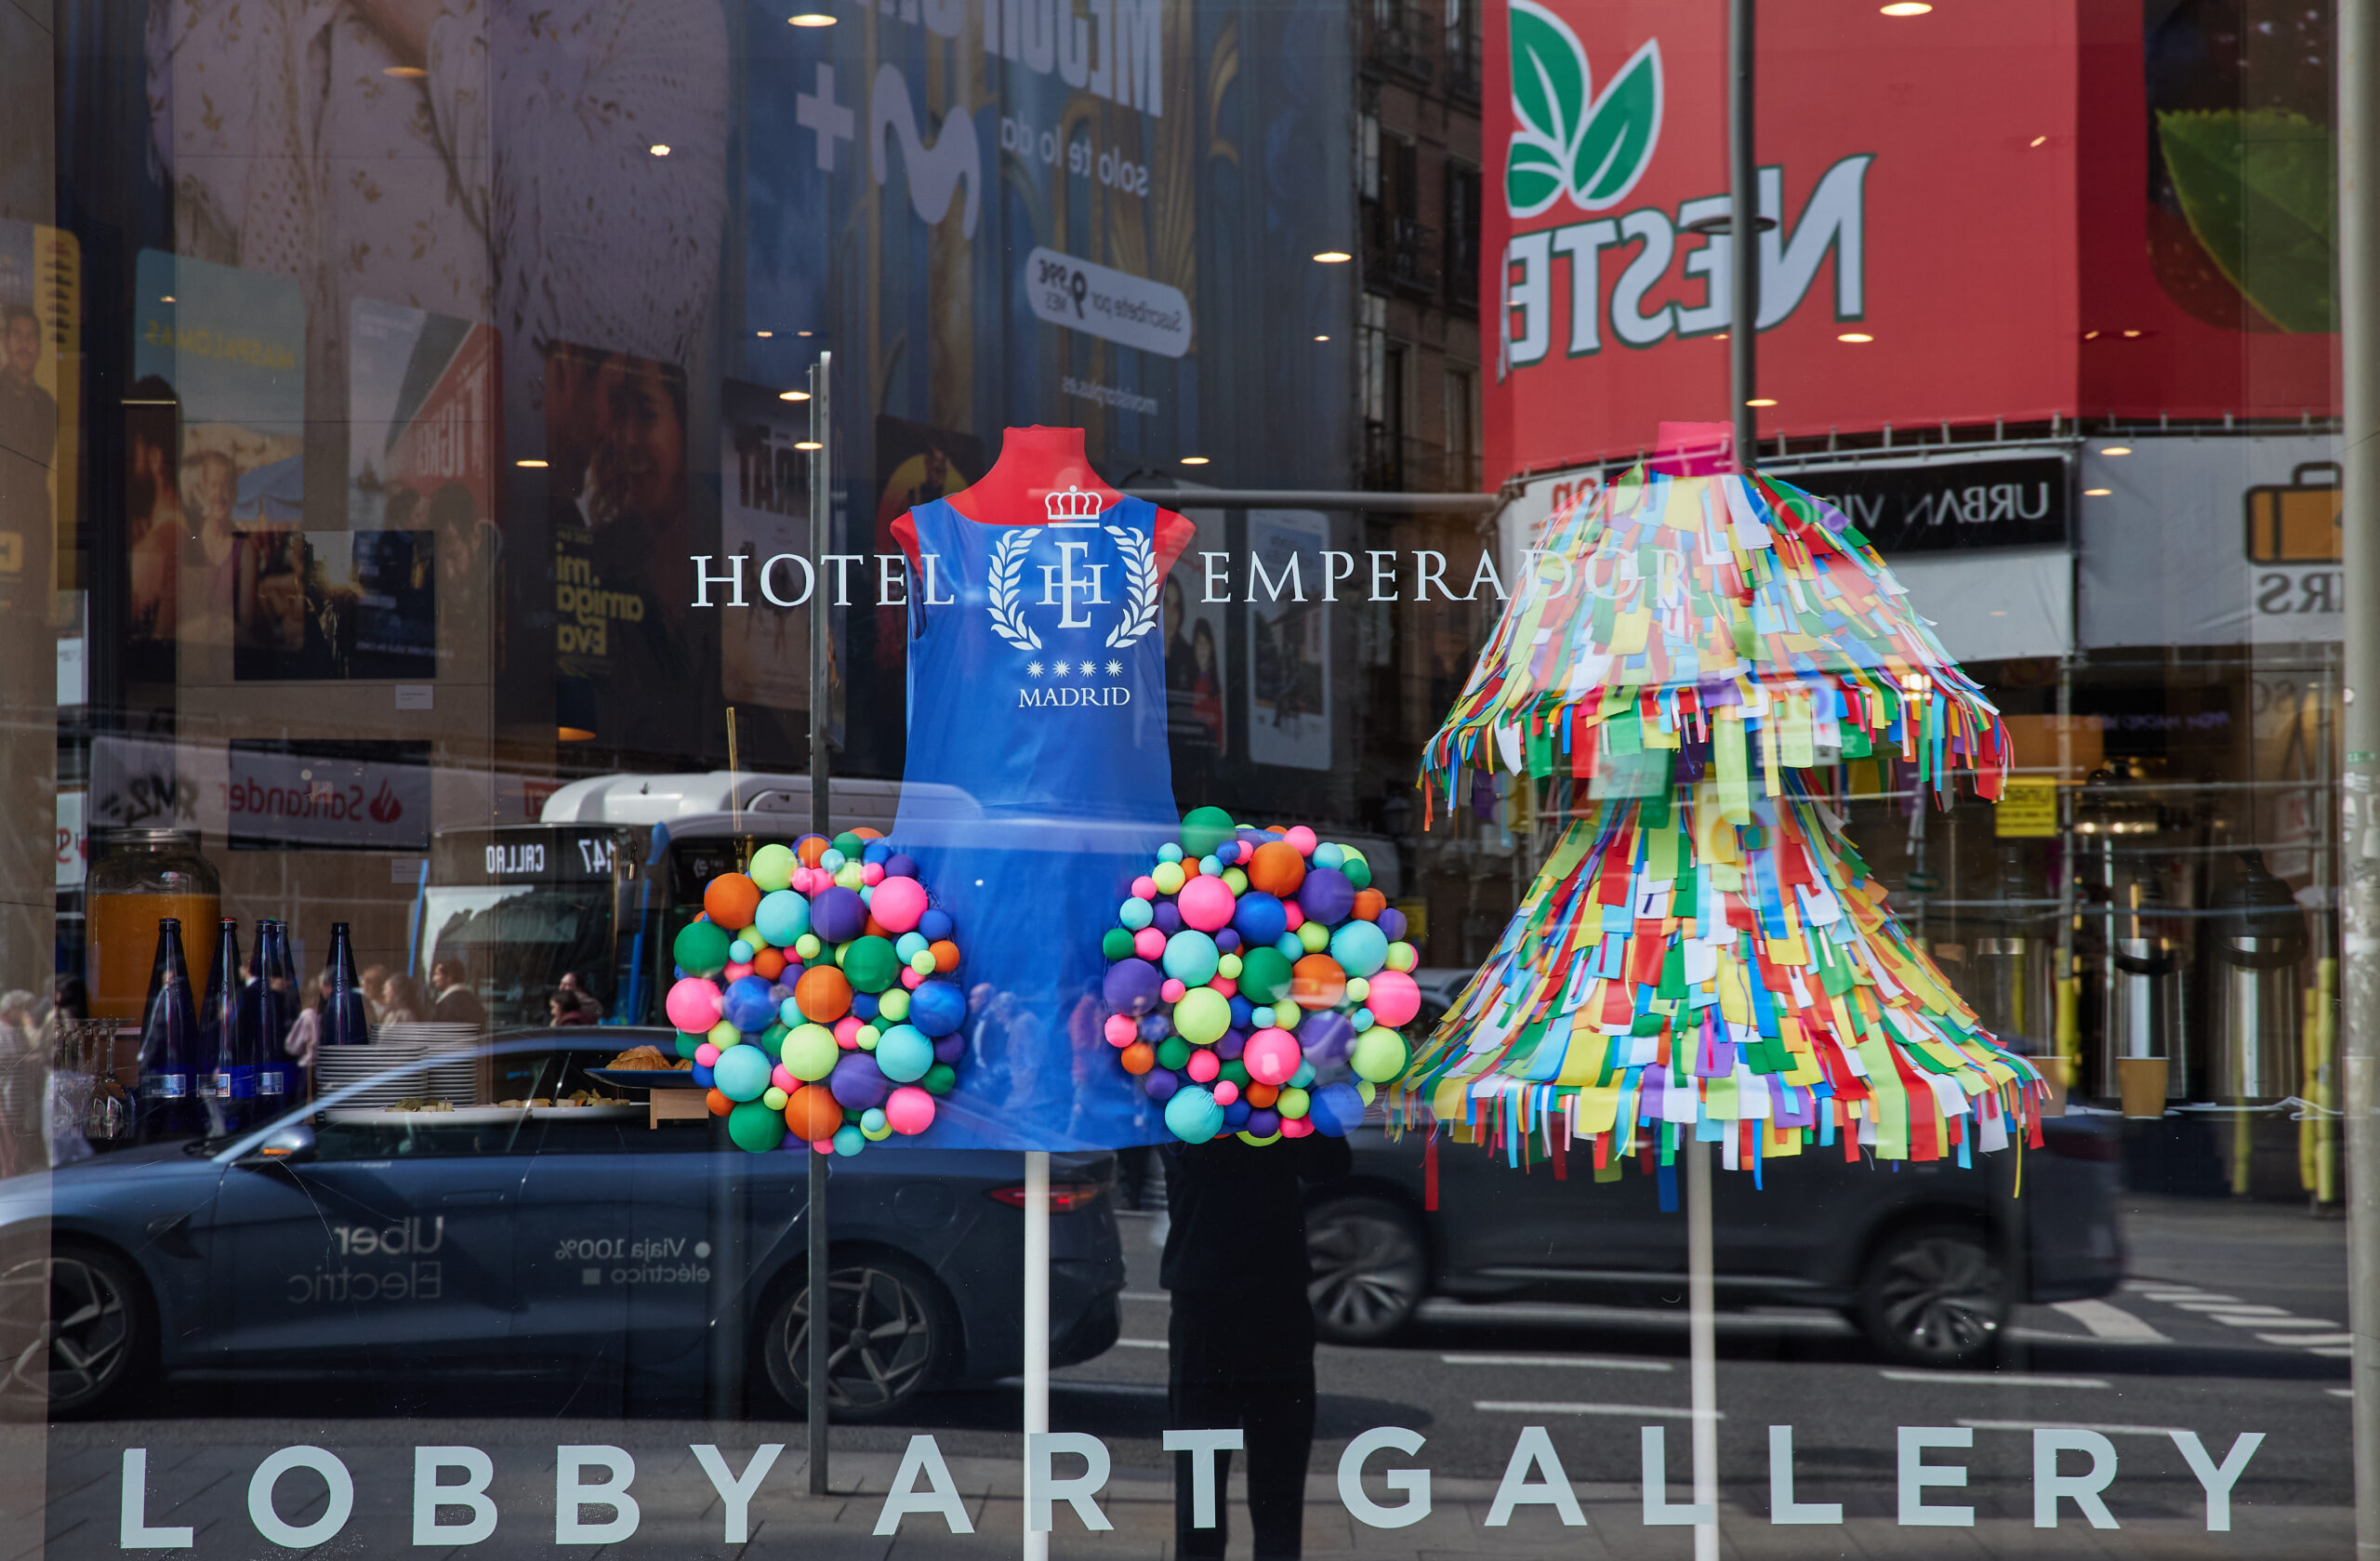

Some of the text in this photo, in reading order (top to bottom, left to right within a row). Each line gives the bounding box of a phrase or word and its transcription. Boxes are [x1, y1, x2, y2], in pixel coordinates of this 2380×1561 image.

[691, 553, 955, 608] HOTEL
[1197, 549, 1702, 604] EMPERADOR
[1018, 687, 1131, 708] MADRID
[121, 1424, 2267, 1549] LOBBY ART GALLERY
